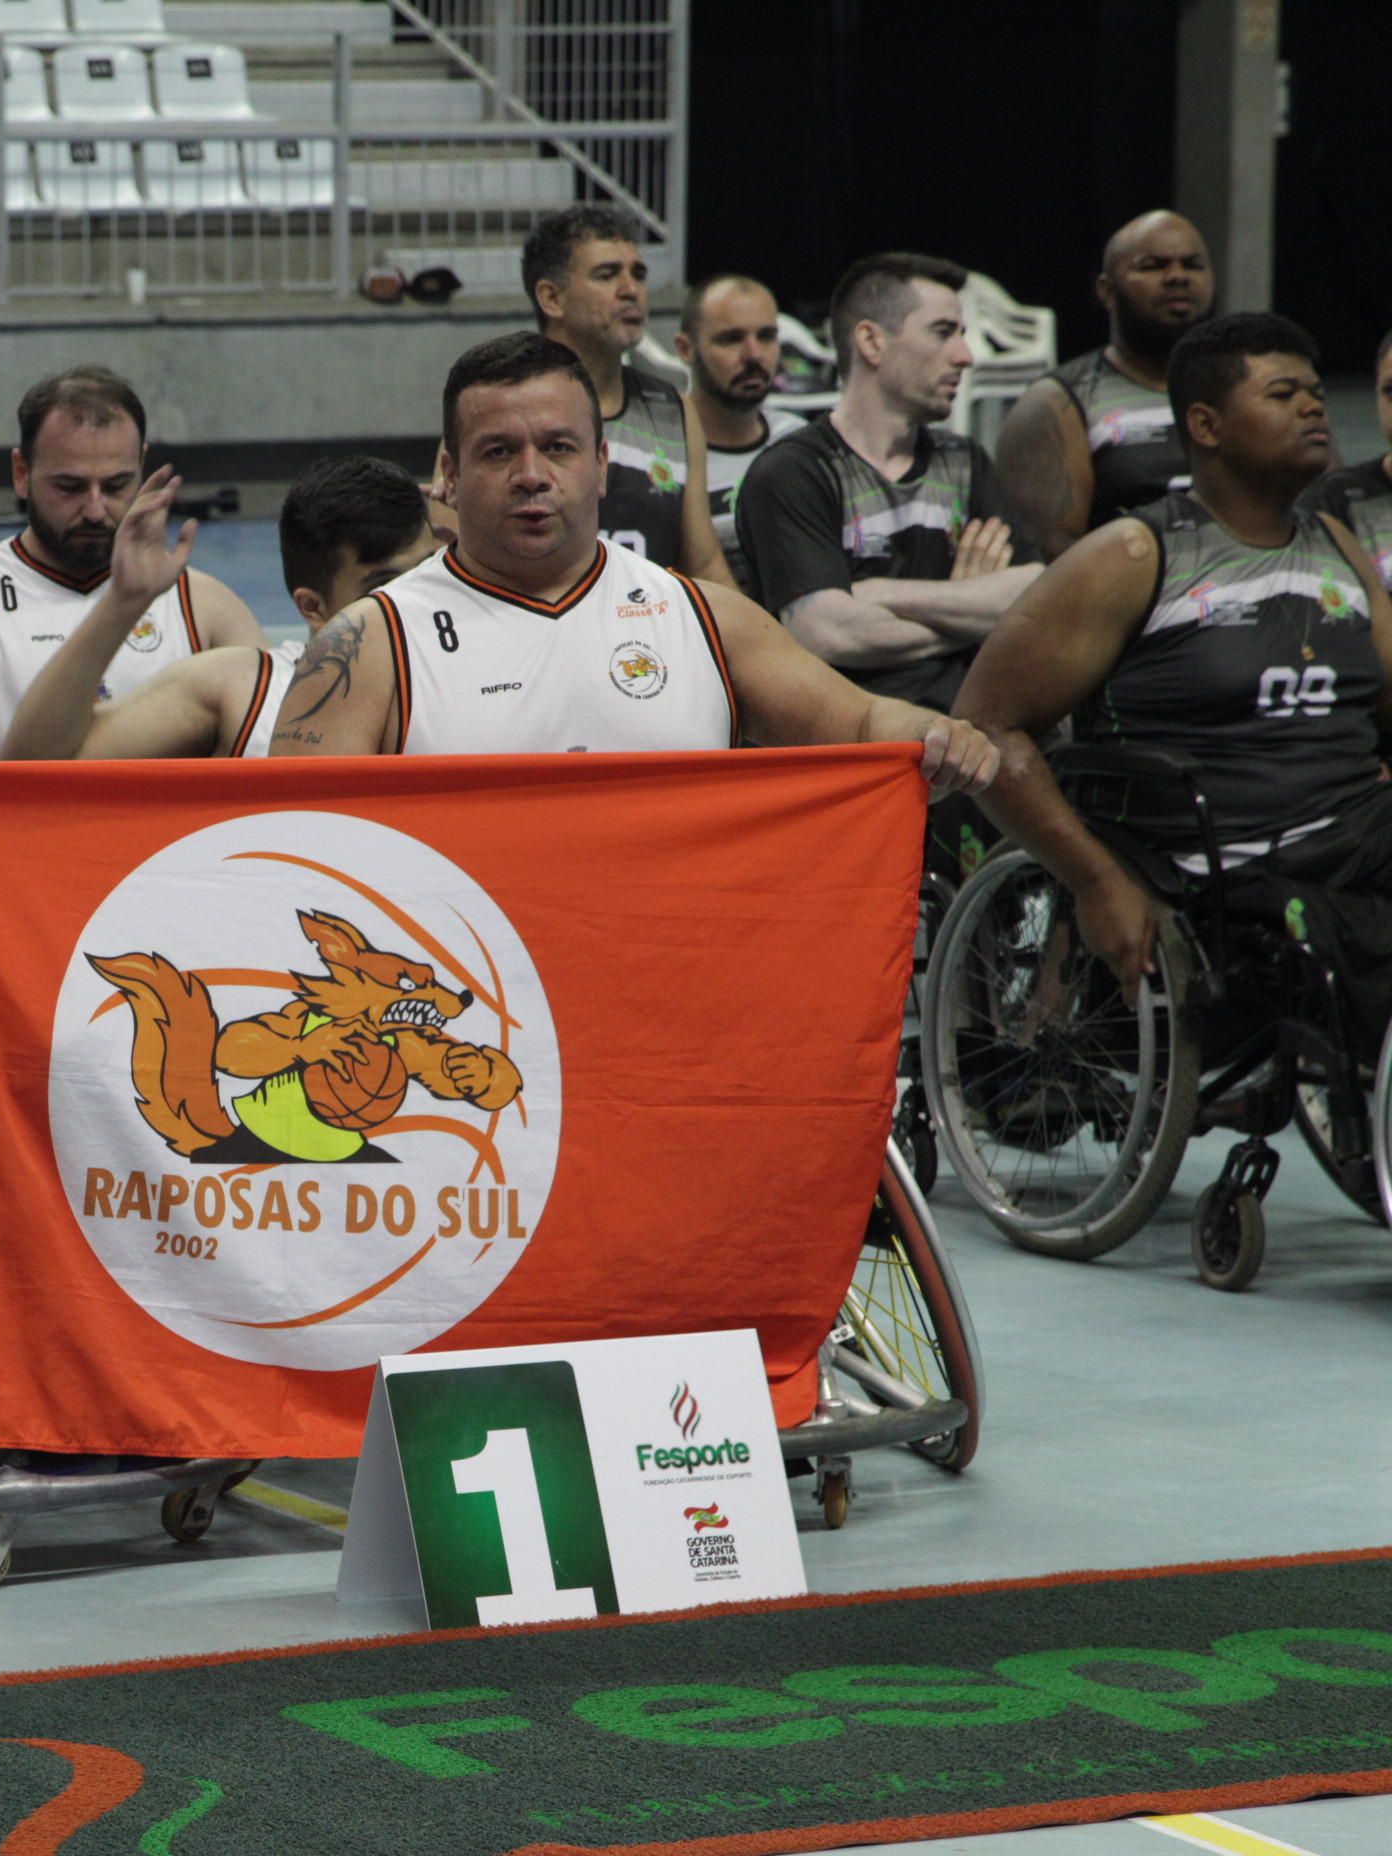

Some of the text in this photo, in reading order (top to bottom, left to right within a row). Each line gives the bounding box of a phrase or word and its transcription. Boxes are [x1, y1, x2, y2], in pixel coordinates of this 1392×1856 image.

[0, 575, 18, 612] 6
[433, 610, 459, 653] 8
[481, 682, 523, 695] RIFFO
[82, 1167, 528, 1240] RAPOSAS DO SUL
[154, 1231, 219, 1262] 2002
[636, 1438, 750, 1475] Fesporte
[725, 1471, 752, 1481] ESPORTE
[450, 1427, 598, 1627] 1
[687, 1534, 735, 1547] GOVERNO
[688, 1545, 736, 1558] DE SANTA
[690, 1555, 739, 1568] CATARINA
